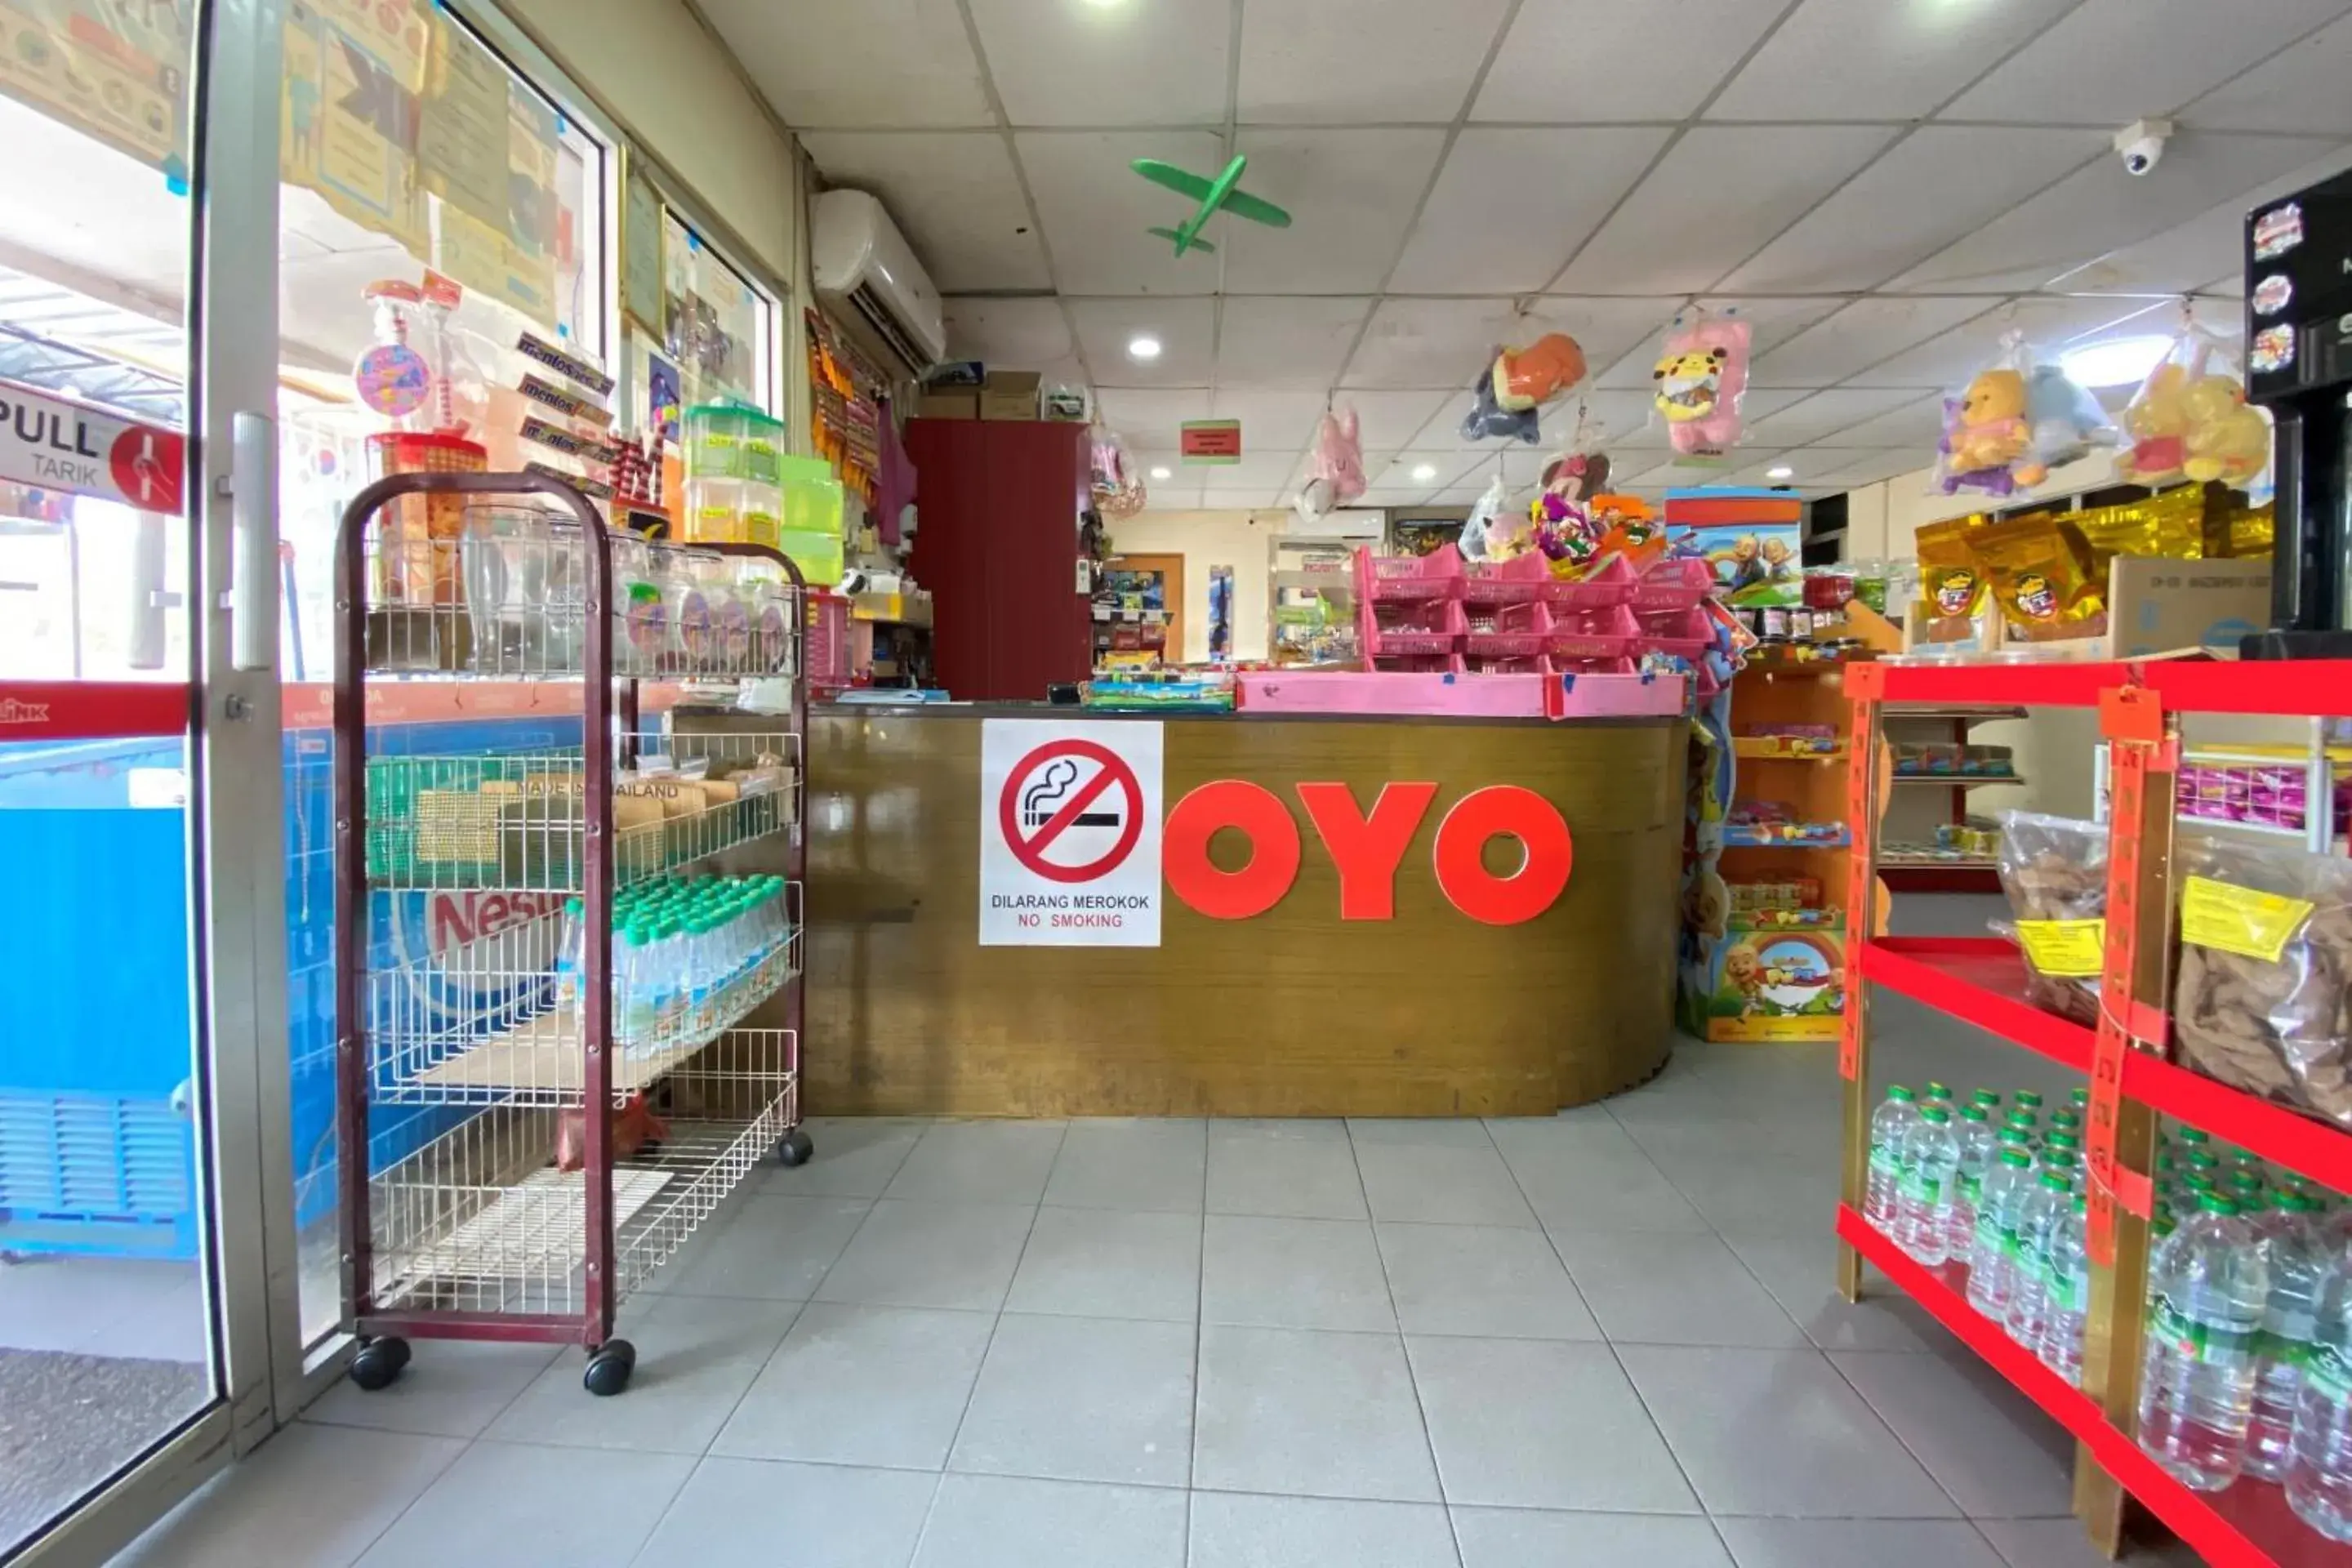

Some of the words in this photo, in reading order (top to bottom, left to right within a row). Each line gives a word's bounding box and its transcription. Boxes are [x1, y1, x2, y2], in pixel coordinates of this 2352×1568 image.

[523, 382, 574, 415] mentos
[527, 425, 577, 452] mntos
[31, 452, 99, 488] TARIK
[614, 782, 679, 798] AILAND
[1161, 779, 1573, 925] OYO
[991, 894, 1069, 909] DILARANG
[1073, 894, 1150, 909] MEROKOK
[1018, 913, 1040, 928] NO
[1051, 913, 1122, 928] SMOKING
